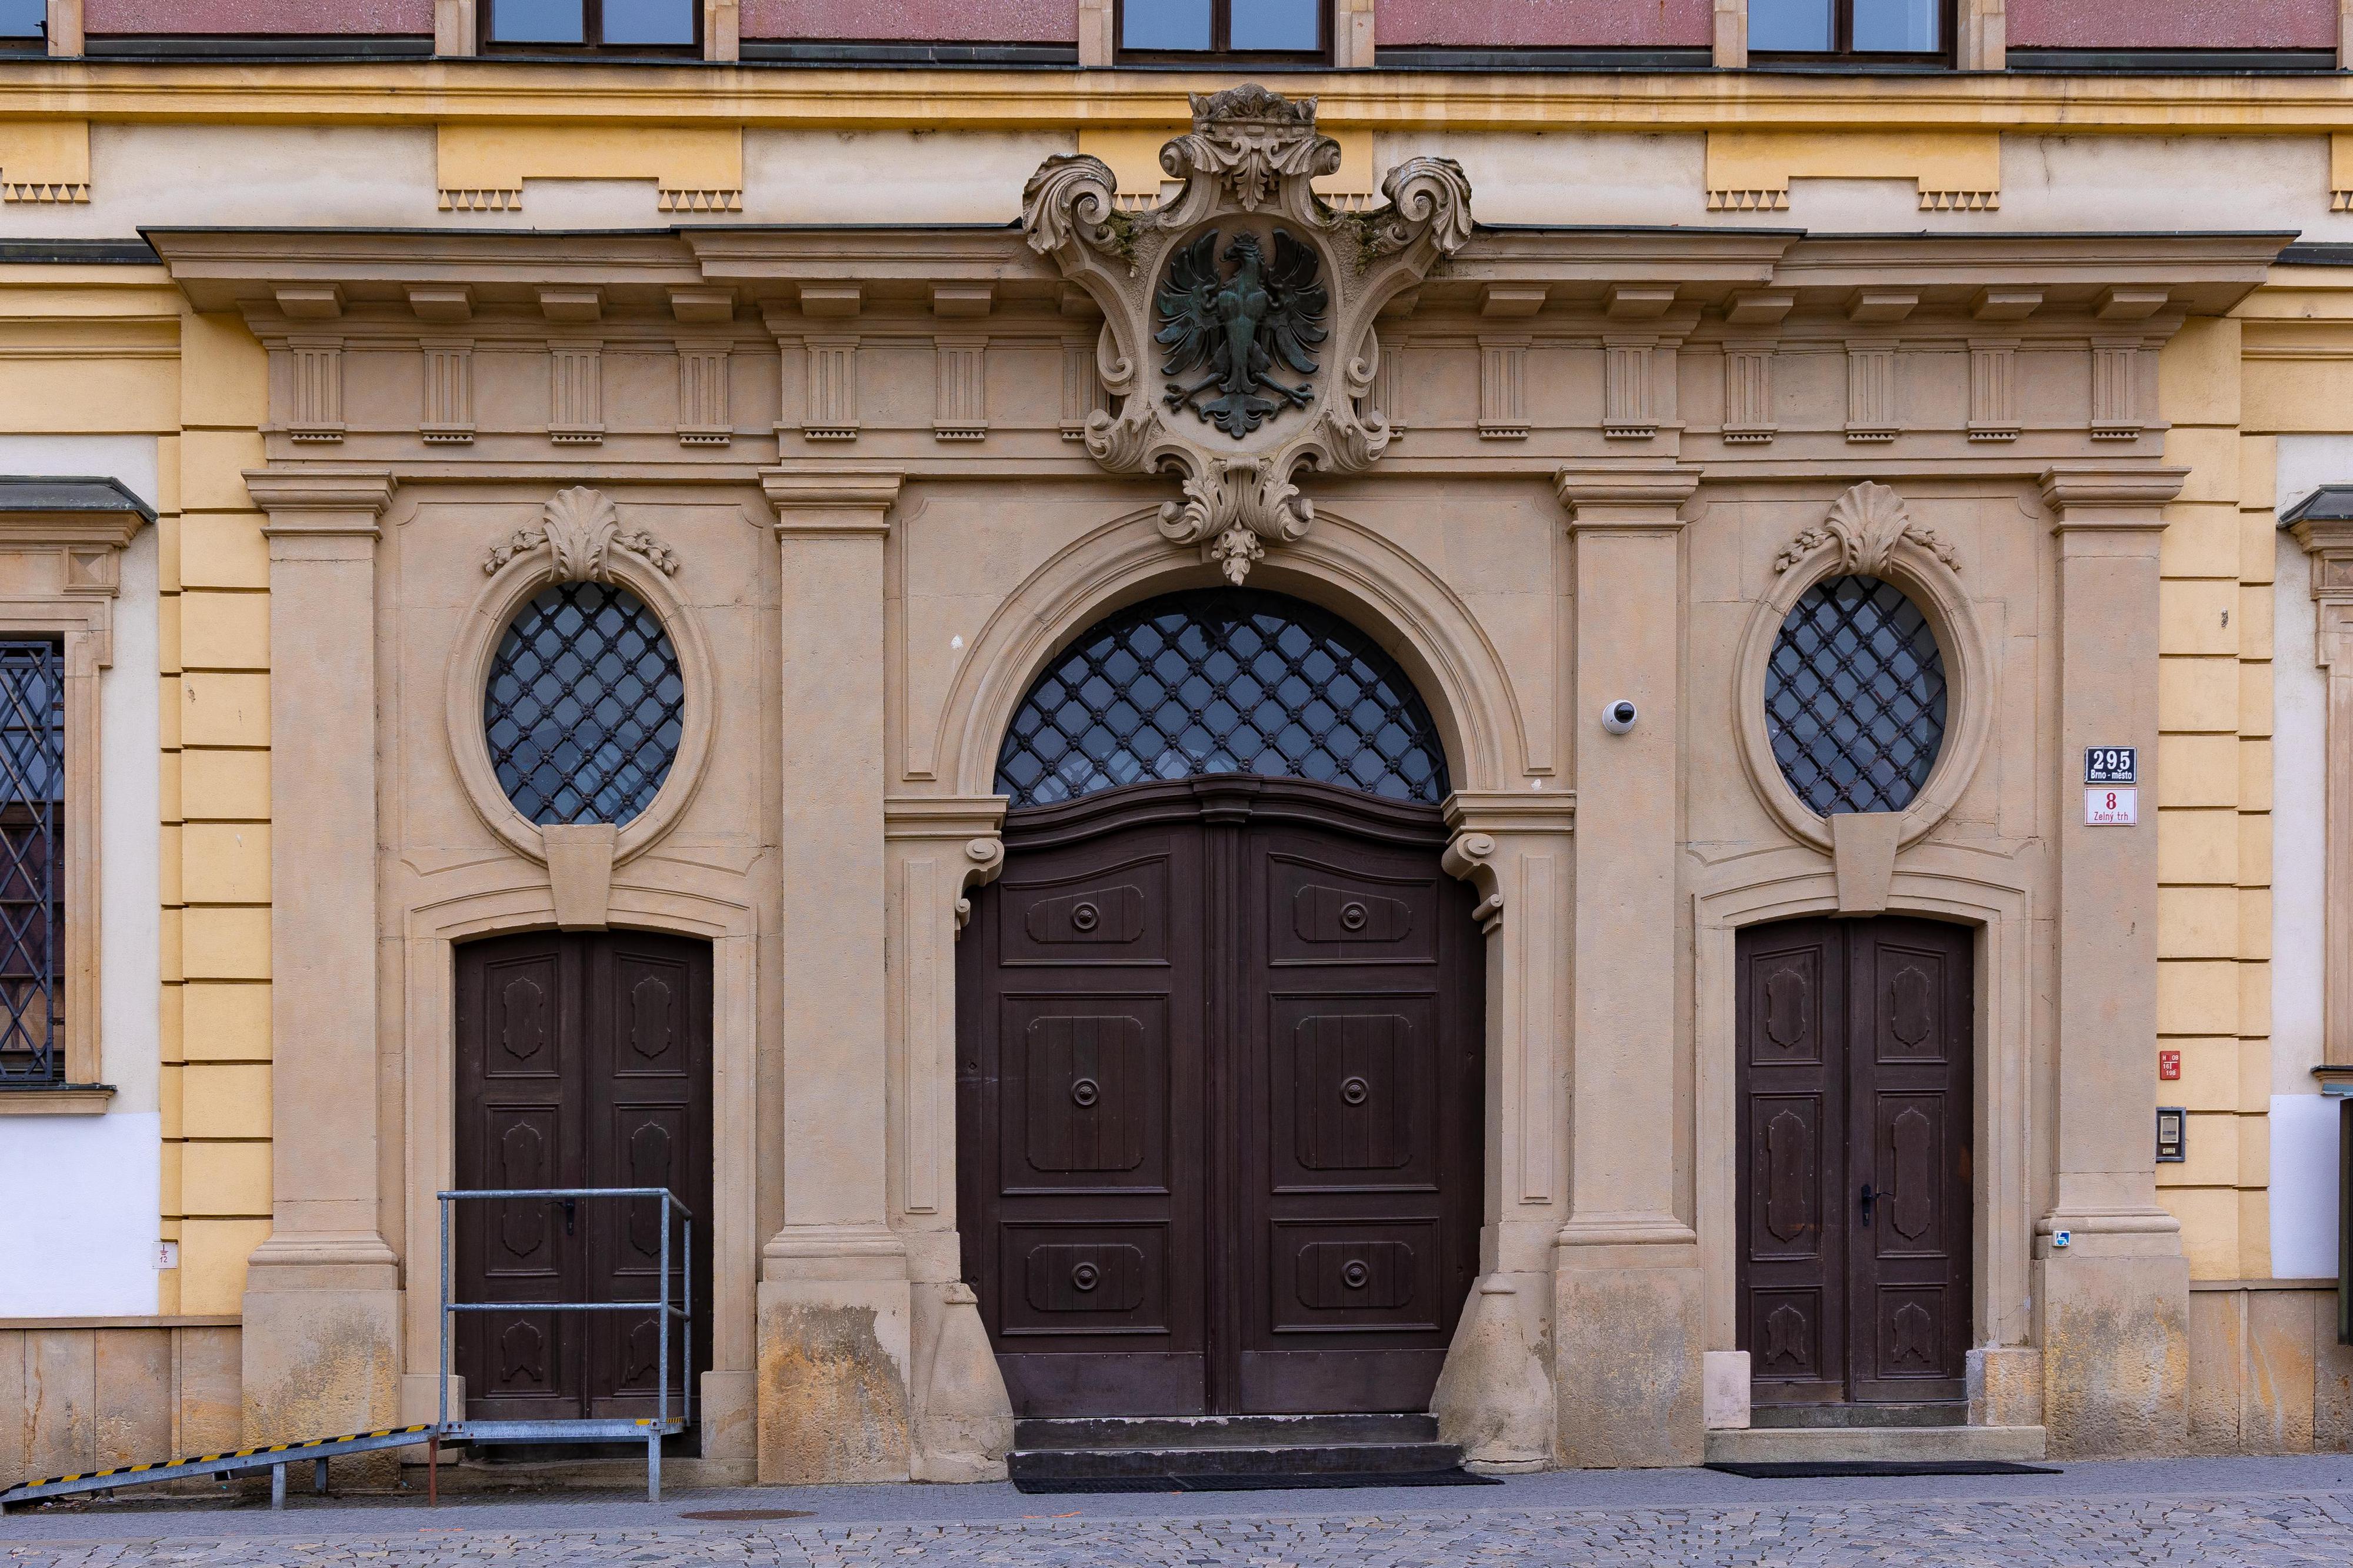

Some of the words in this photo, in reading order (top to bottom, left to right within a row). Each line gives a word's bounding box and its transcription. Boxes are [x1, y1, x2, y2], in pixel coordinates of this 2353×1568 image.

[2093, 750, 2130, 770] 295
[2091, 769, 2107, 779] Brno
[2111, 769, 2132, 779] město
[2106, 792, 2117, 810] 8
[2094, 811, 2114, 822] Zelný
[2117, 812, 2128, 821] trh
